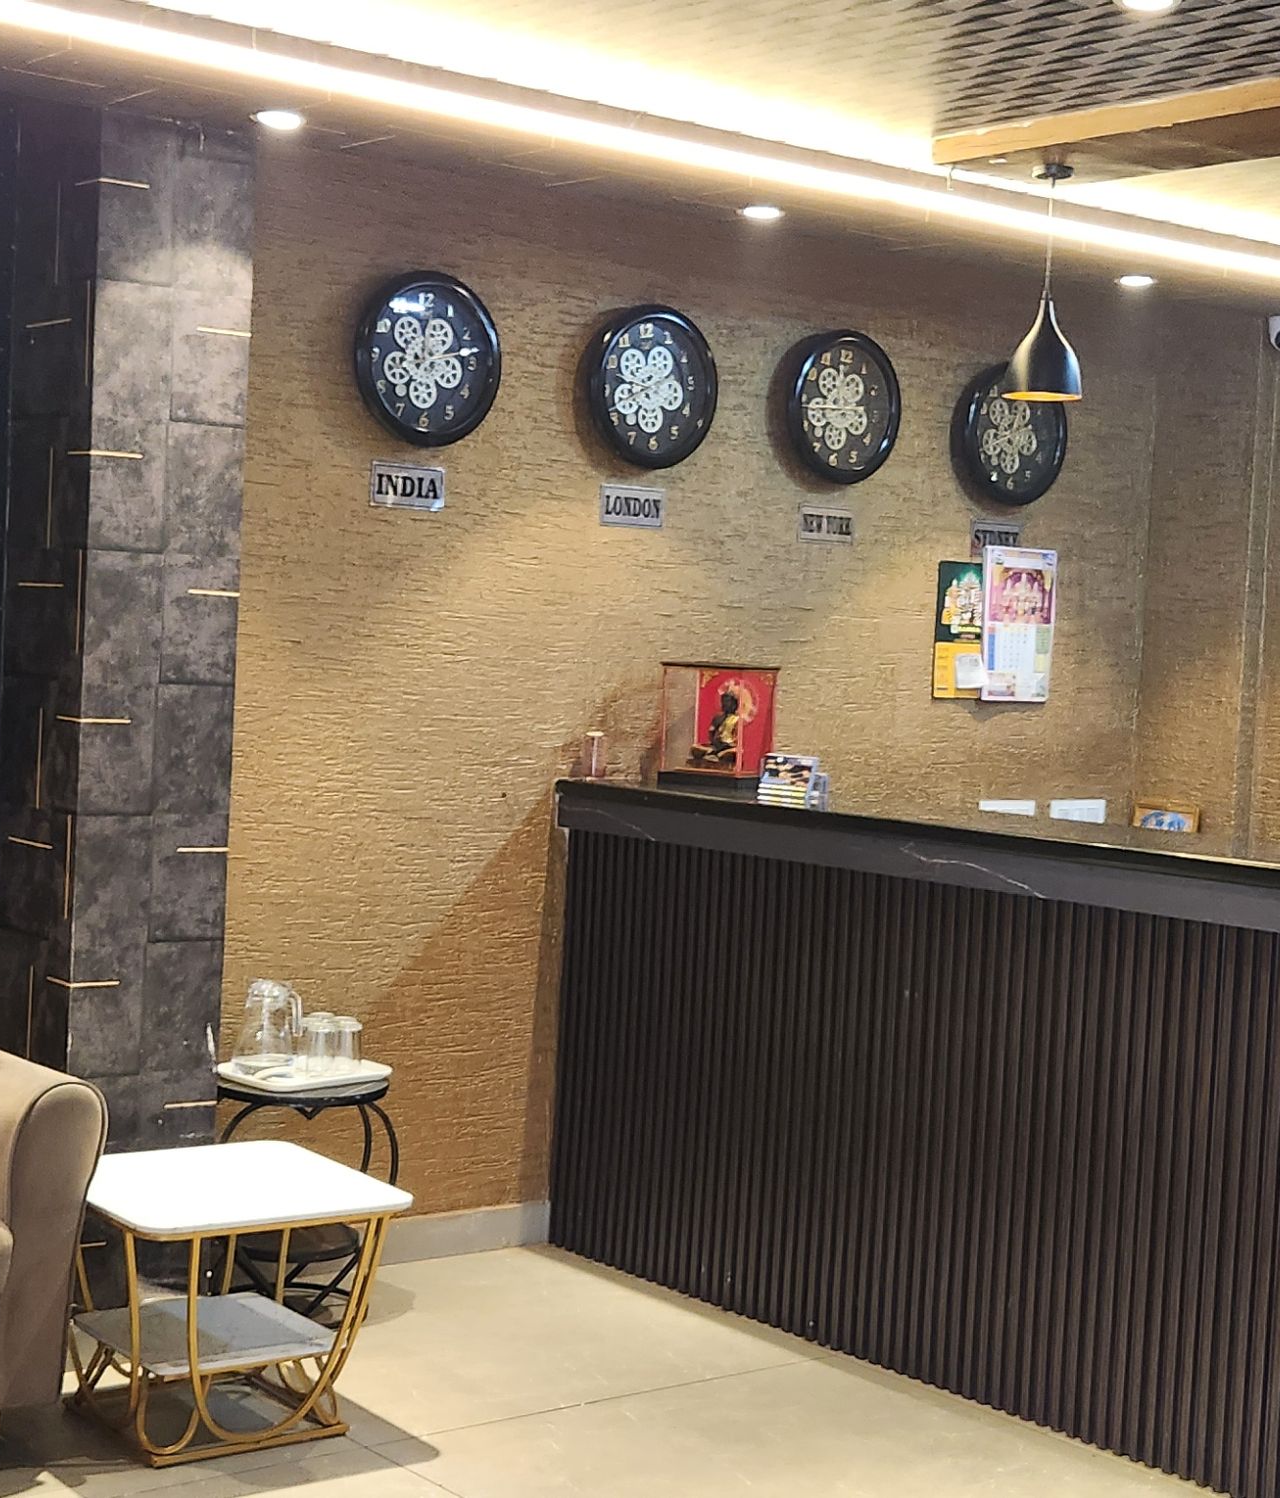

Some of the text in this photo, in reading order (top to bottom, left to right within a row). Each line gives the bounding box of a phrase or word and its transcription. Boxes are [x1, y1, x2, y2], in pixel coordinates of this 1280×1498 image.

[418, 292, 435, 308] 12
[462, 327, 471, 341] 2
[639, 322, 654, 339] 12
[663, 331, 674, 345] 1
[468, 357, 477, 371] 3
[460, 385, 470, 399] 4
[395, 403, 405, 417] 7
[444, 405, 455, 420] 5
[682, 402, 691, 418] 4
[419, 412, 430, 427] 6
[627, 431, 637, 445] 7
[670, 425, 679, 440] 5
[648, 435, 659, 451] 6
[376, 473, 440, 500] INDIA
[604, 495, 661, 519] LONDON
[802, 513, 824, 533] NEW
